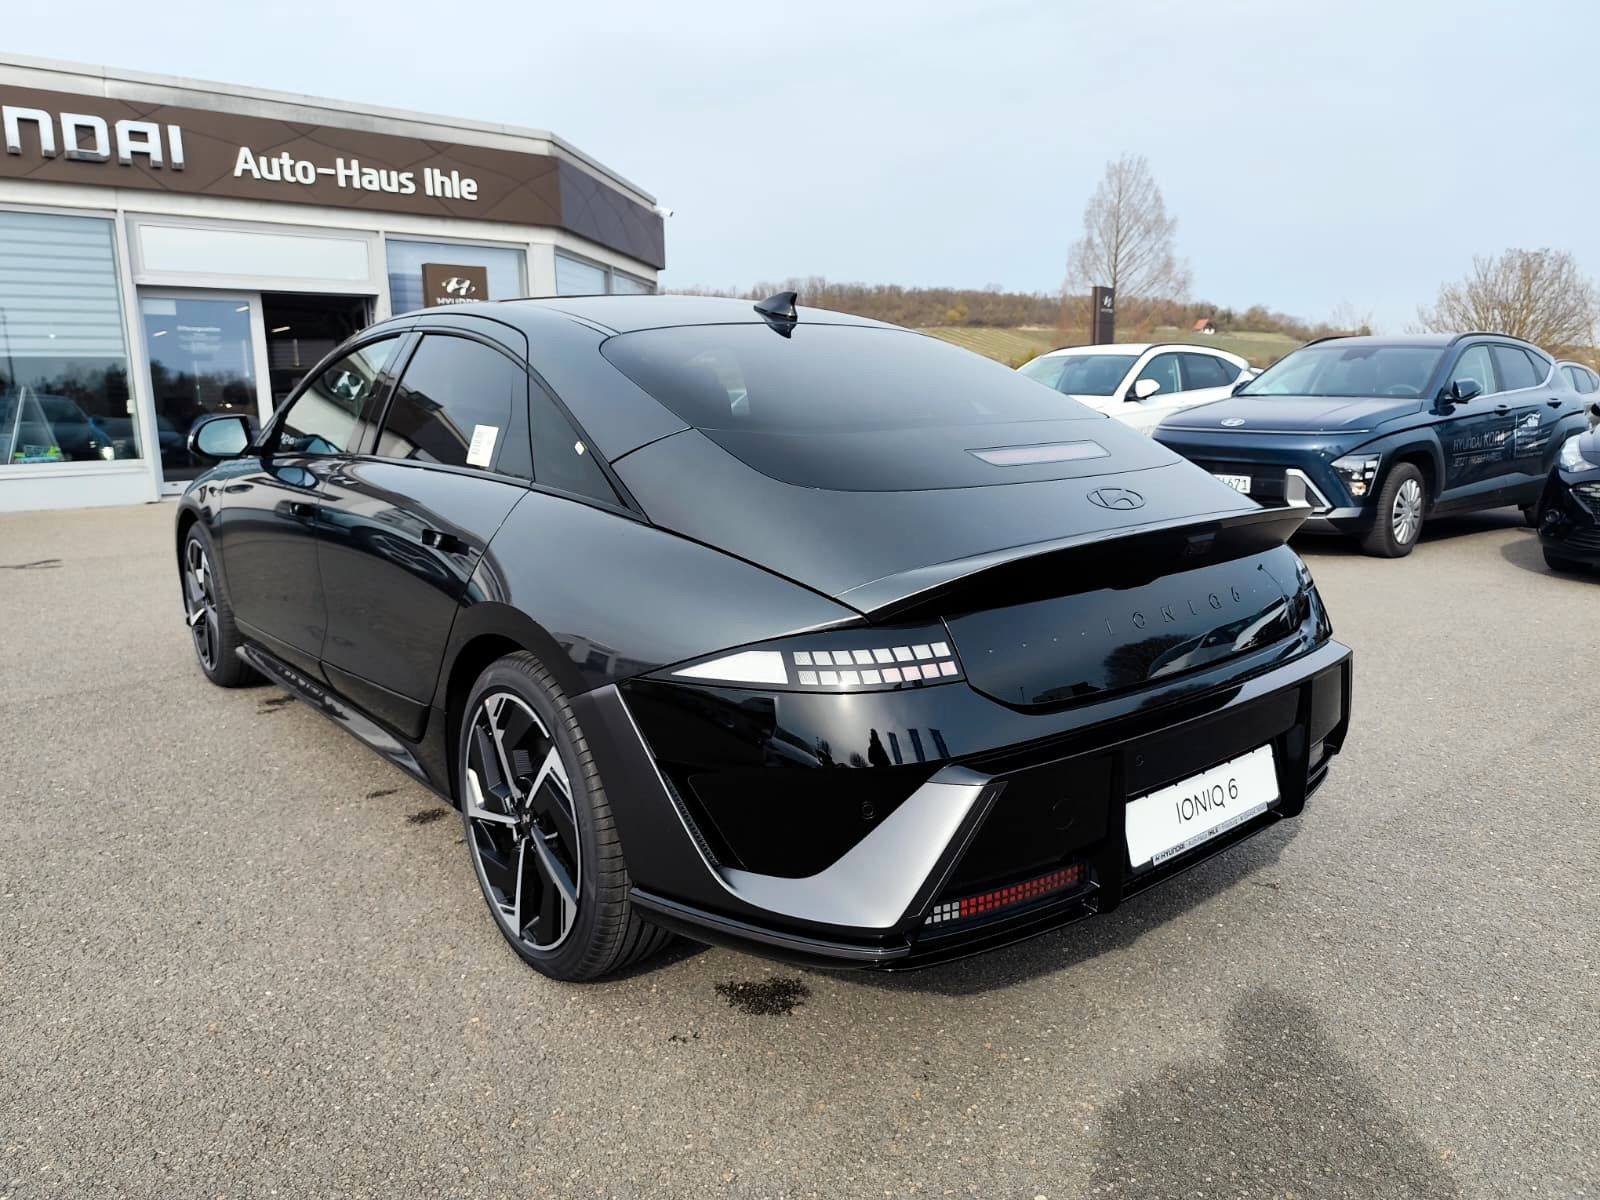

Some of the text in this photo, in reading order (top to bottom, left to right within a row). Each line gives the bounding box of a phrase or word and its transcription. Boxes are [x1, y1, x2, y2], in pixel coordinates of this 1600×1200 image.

[233, 146, 478, 201] Auto-Haus Ihle
[437, 297, 480, 305] HYUND
[1176, 785, 1225, 824] IONIQ
[1228, 778, 1238, 800] 6
